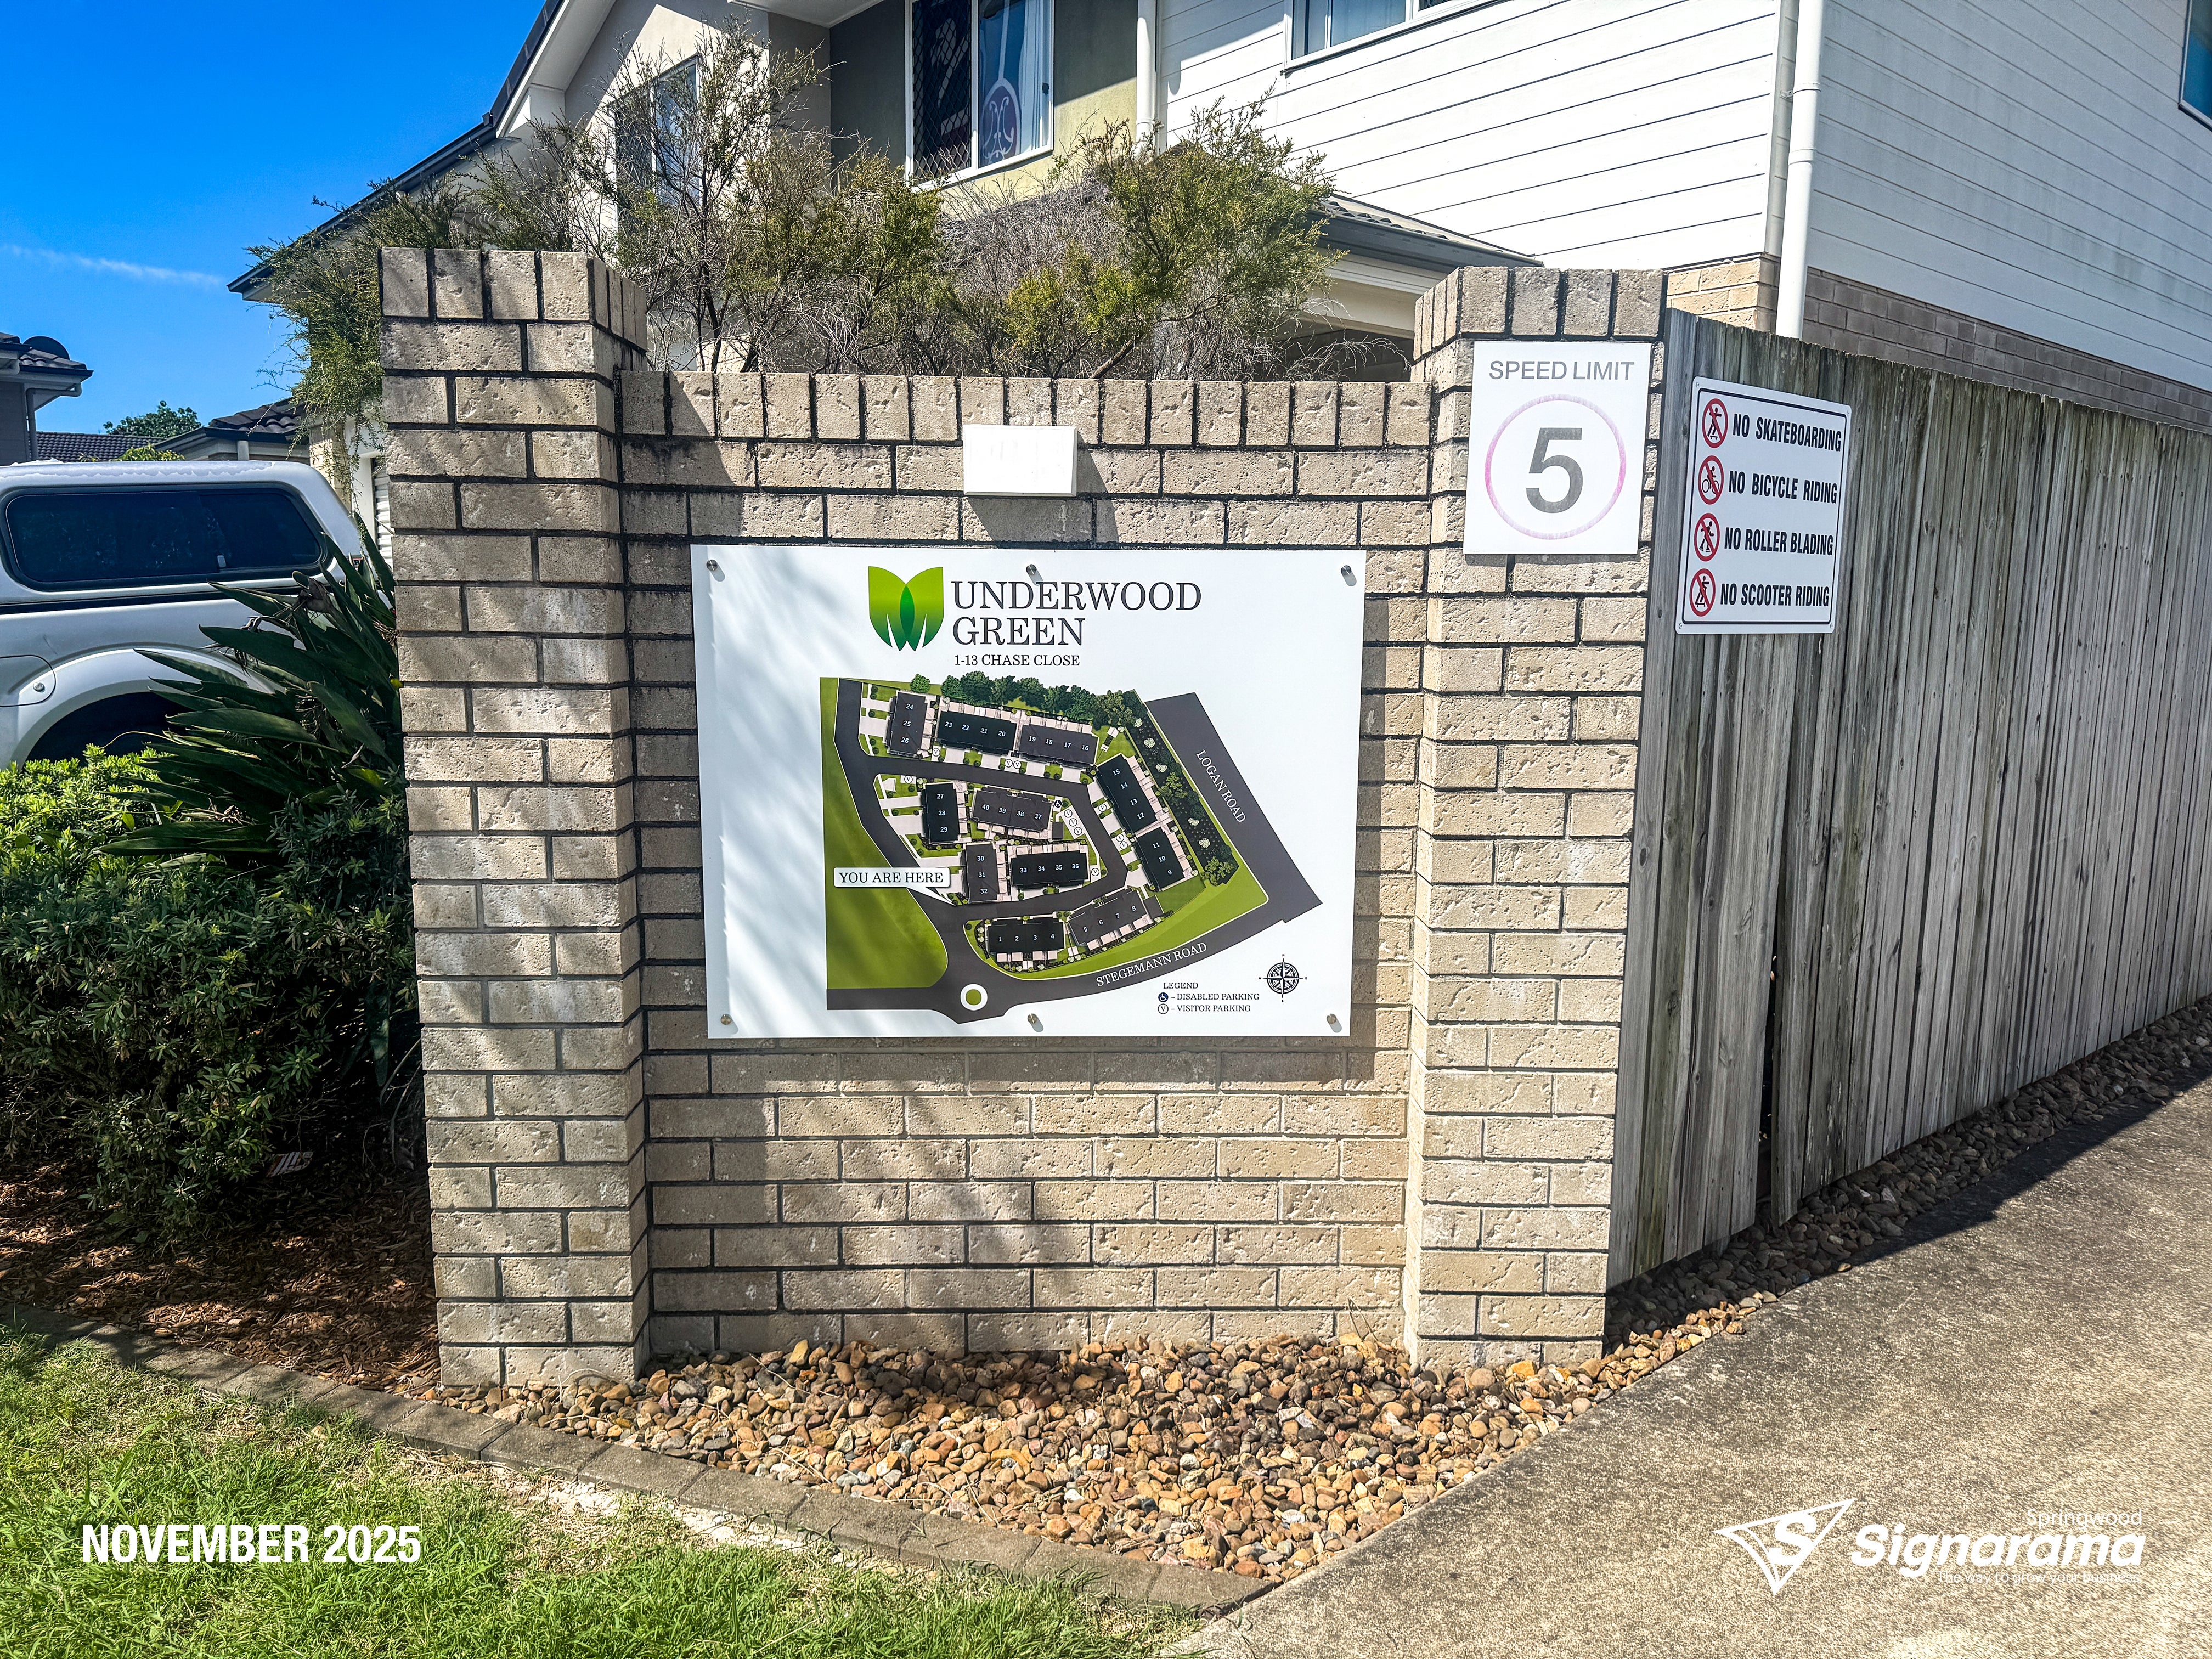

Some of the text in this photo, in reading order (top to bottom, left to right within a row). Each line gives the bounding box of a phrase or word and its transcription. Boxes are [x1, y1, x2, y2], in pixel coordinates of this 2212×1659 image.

[1489, 360, 1635, 380] SPEED LIMIT
[1733, 413, 1842, 452] NO SKATEBOARDING
[1526, 427, 1583, 513] 5
[1728, 470, 1837, 504] NO BICYCLE RIDING
[1724, 527, 1833, 556] NO ROLLER BLADING
[951, 580, 1201, 610] UNDERWOOD
[1720, 583, 1830, 607] NO SCOOTER RIDING
[952, 617, 1086, 646] GREEN
[955, 654, 1080, 666] 1-13 CHASE CLOSE
[1196, 749, 1246, 822] LOGAN ROAD
[839, 872, 943, 883] YOU ARE HERE
[1096, 943, 1207, 987] STEGEMANN ROAD
